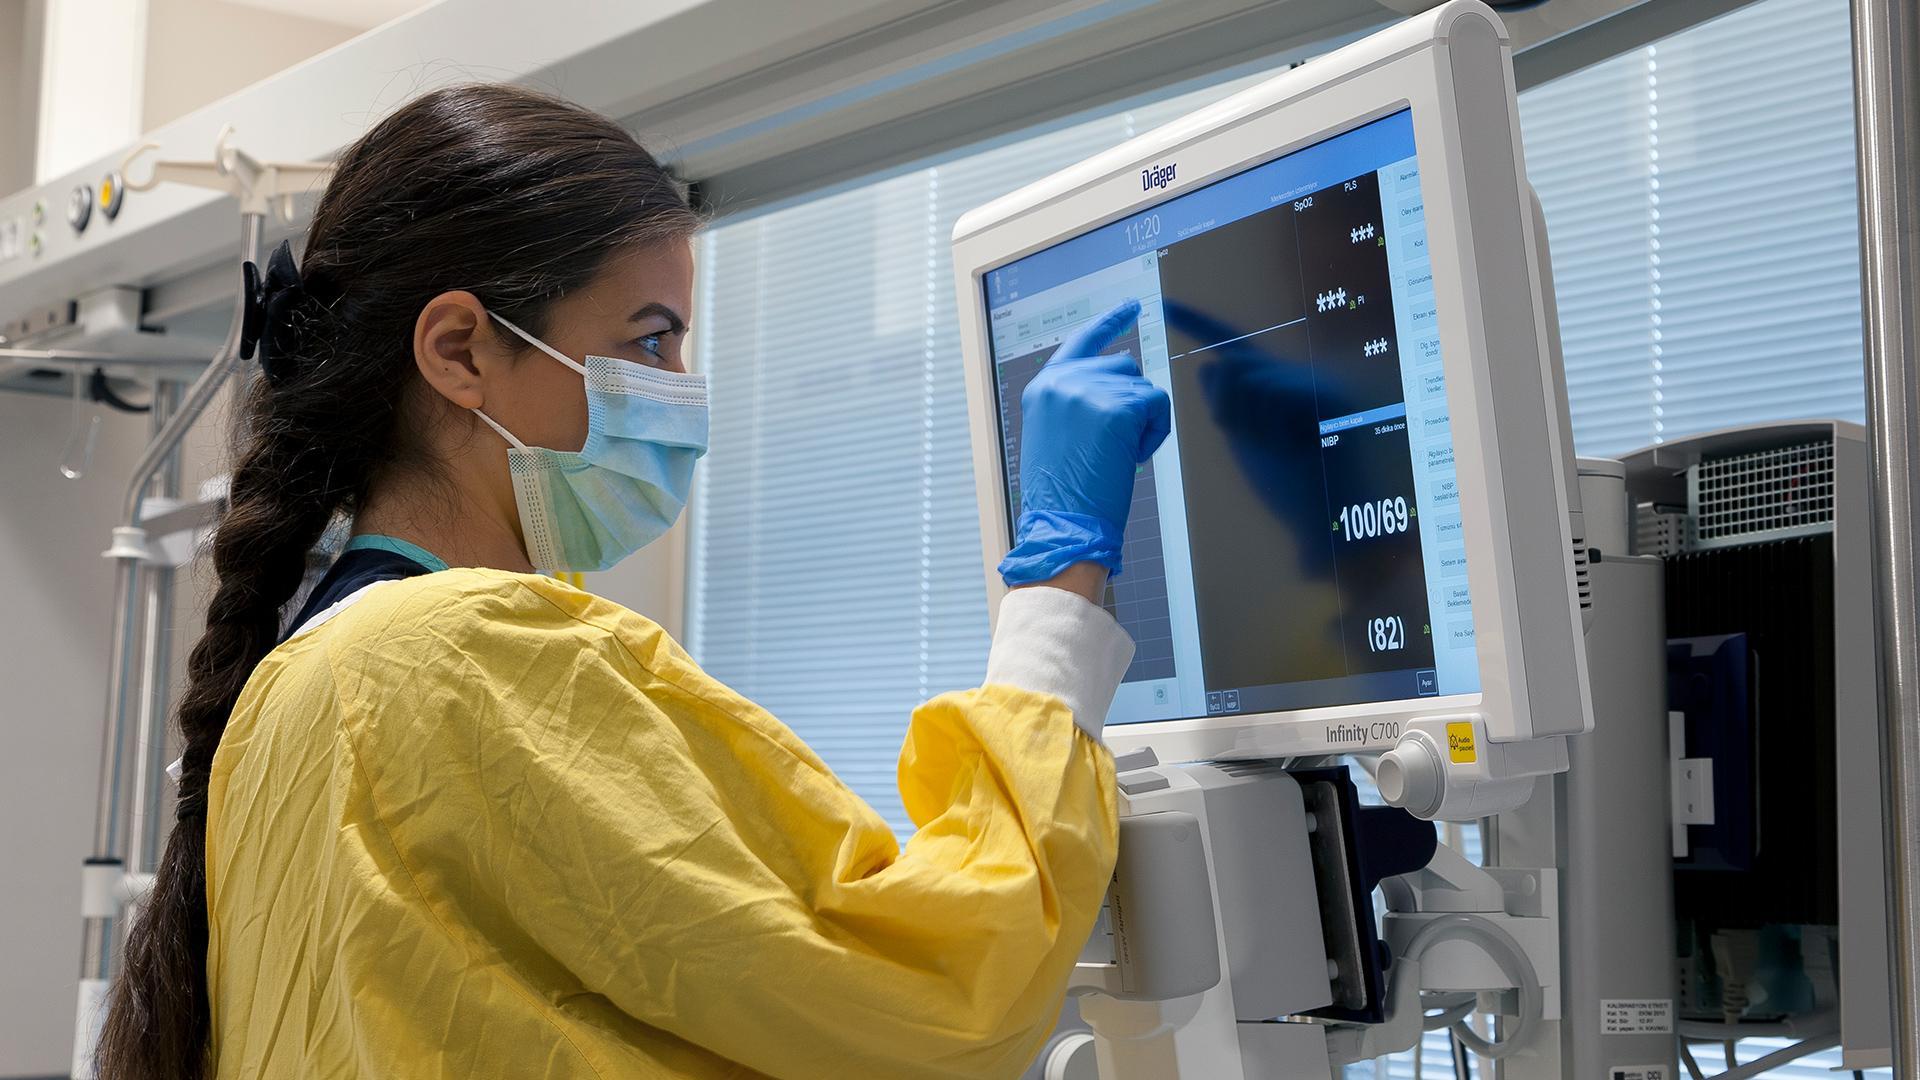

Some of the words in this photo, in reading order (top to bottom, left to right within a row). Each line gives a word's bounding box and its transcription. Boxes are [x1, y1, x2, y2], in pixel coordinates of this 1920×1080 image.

[1142, 163, 1177, 191] Dräger
[1344, 180, 1358, 192] PLS
[1294, 196, 1313, 212] SpO2
[1124, 214, 1160, 245] 11:20
[1321, 434, 1340, 448] NIBP
[1374, 427, 1380, 436] 35
[1339, 496, 1409, 542] 100/69
[1368, 615, 1404, 652] (82)
[1326, 722, 1368, 746] Infinity
[1370, 722, 1400, 740] C700
